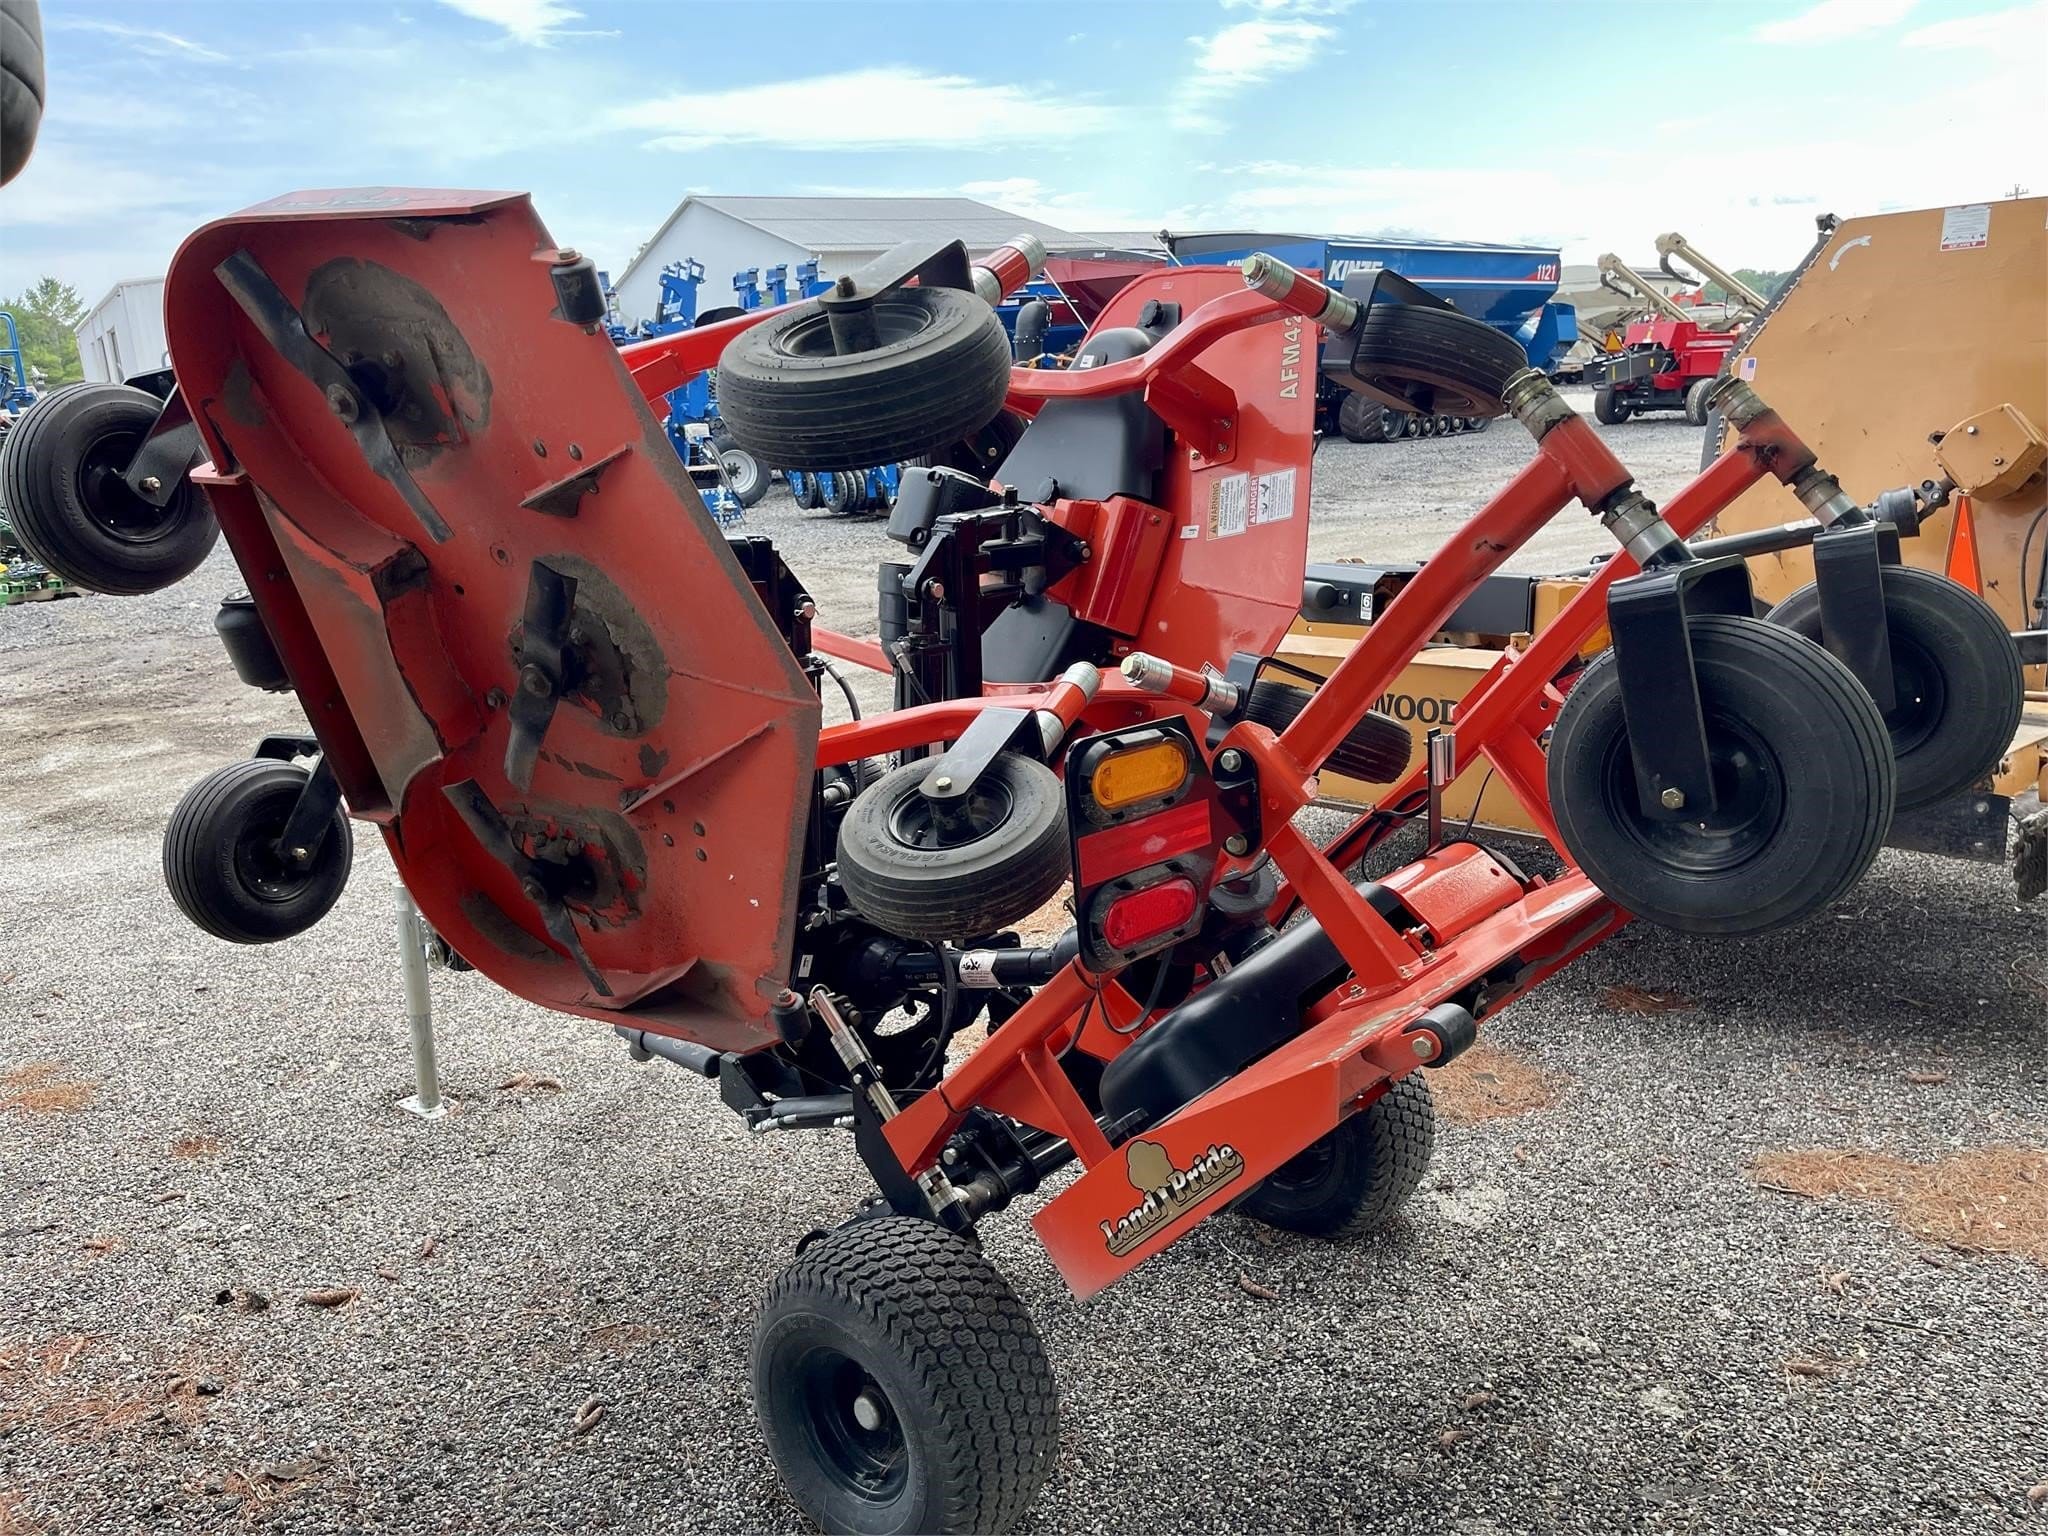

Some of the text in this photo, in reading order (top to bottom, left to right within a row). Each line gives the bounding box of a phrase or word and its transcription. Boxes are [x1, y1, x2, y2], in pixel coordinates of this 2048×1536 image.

[1537, 264, 1556, 281] 1121
[1210, 482, 1220, 522] WARNING
[1249, 476, 1259, 519] DANGER
[1363, 595, 1371, 608] 6
[1100, 1144, 1238, 1249] Land Pride
